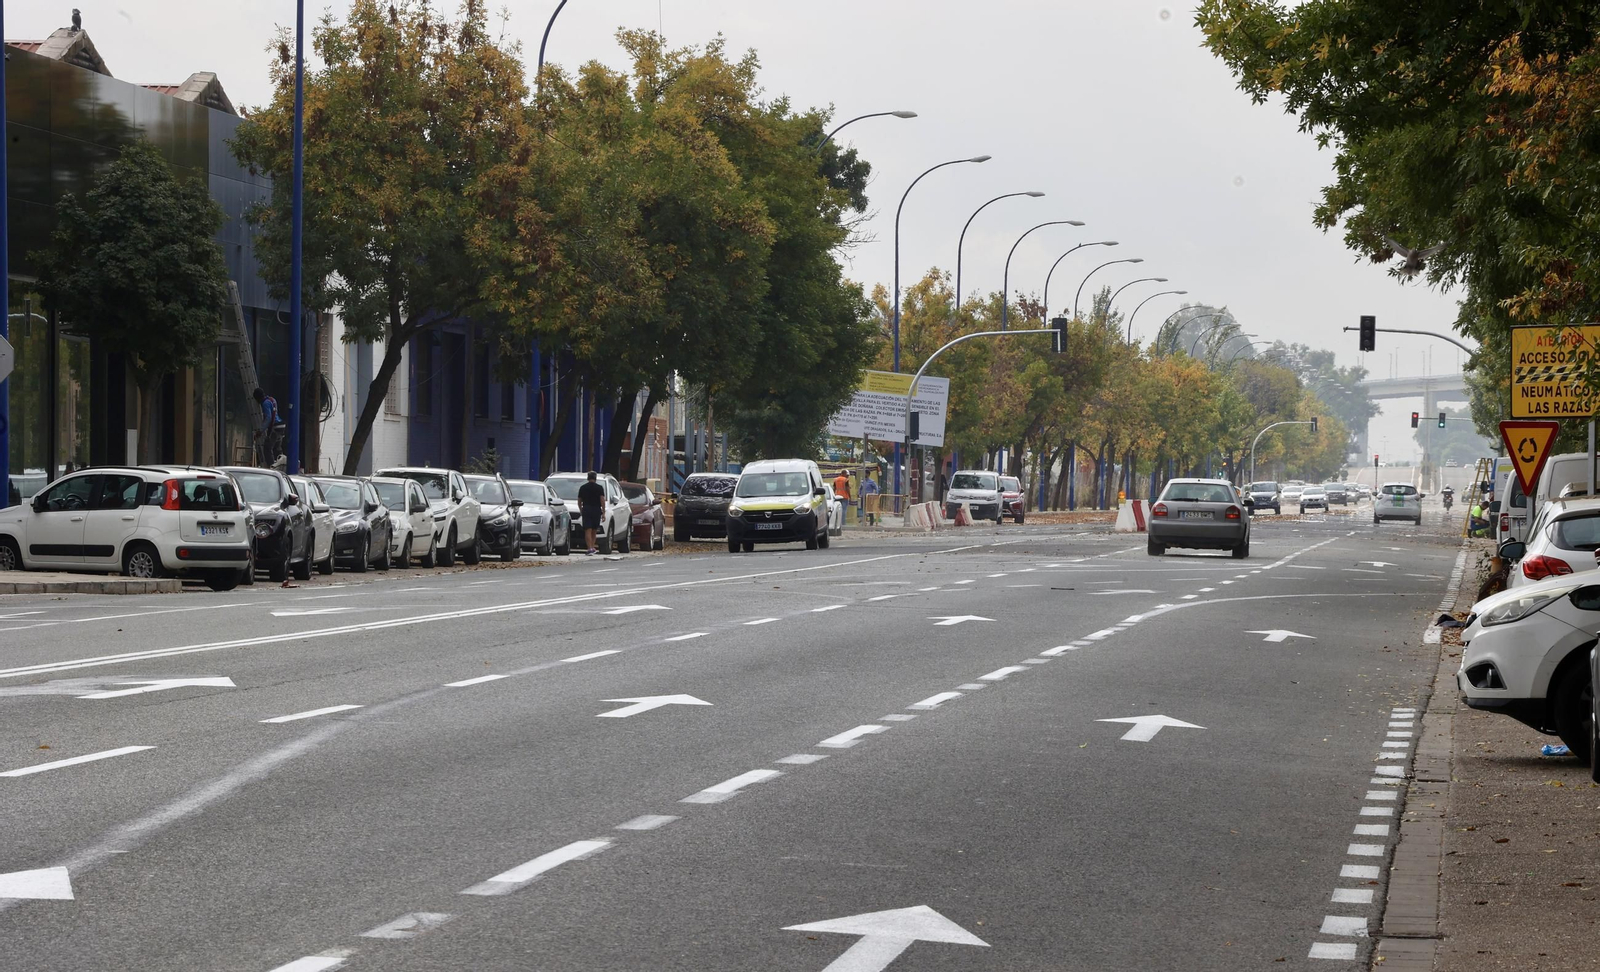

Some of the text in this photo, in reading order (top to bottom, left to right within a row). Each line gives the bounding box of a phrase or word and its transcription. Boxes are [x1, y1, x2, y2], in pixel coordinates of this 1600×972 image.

[1520, 352, 1566, 364] ACCESO
[1521, 382, 1599, 398] NEUMÁTICO
[1528, 401, 1592, 414] LAS RAZAS
